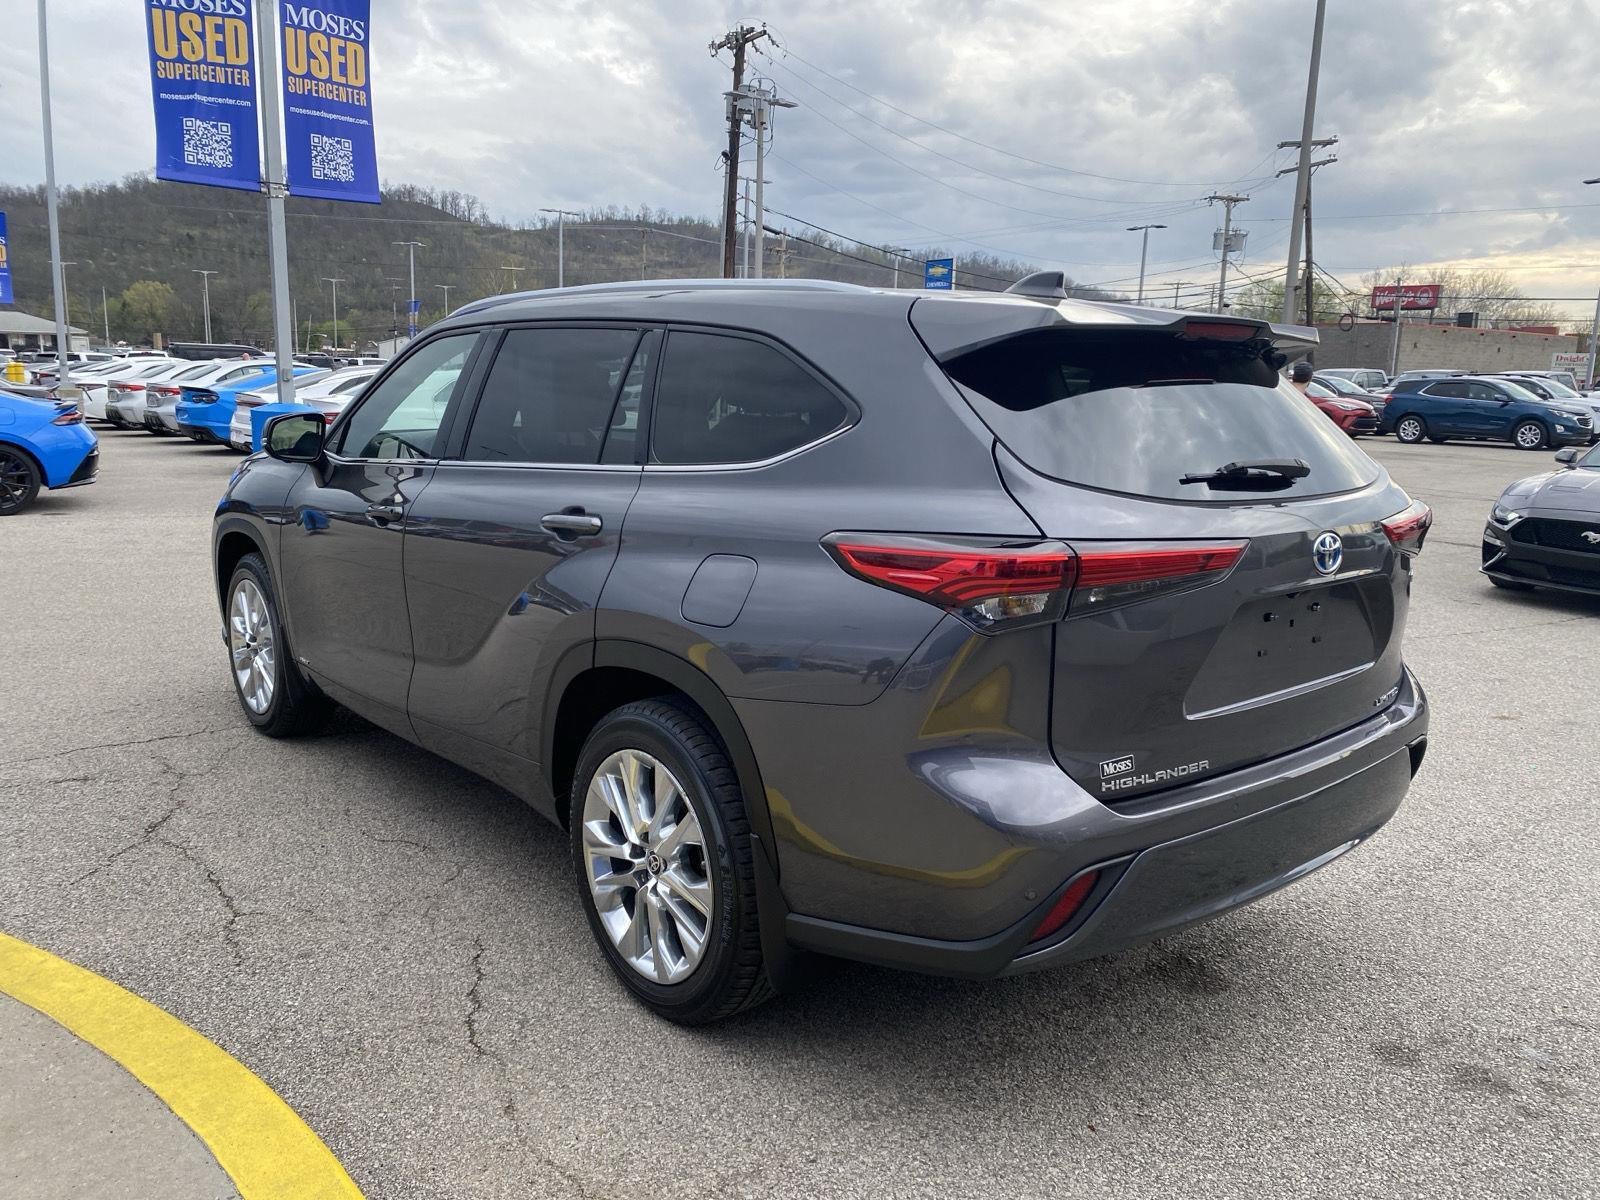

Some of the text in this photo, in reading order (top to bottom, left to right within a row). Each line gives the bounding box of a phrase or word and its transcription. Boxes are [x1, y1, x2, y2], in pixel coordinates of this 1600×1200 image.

[151, 0, 247, 16] SES
[284, 3, 365, 41] MOSES
[151, 7, 249, 66] USED
[285, 26, 366, 87] USED
[156, 60, 250, 87] SUPERCENTER
[160, 91, 252, 107] mosesusedsupercenter.com
[287, 76, 367, 107] SUPERCENTER
[289, 105, 369, 126] mosesusedsupercenter.com
[1101, 760, 1210, 792] HIGHLANDER
[1102, 759, 1132, 776] MOSES
